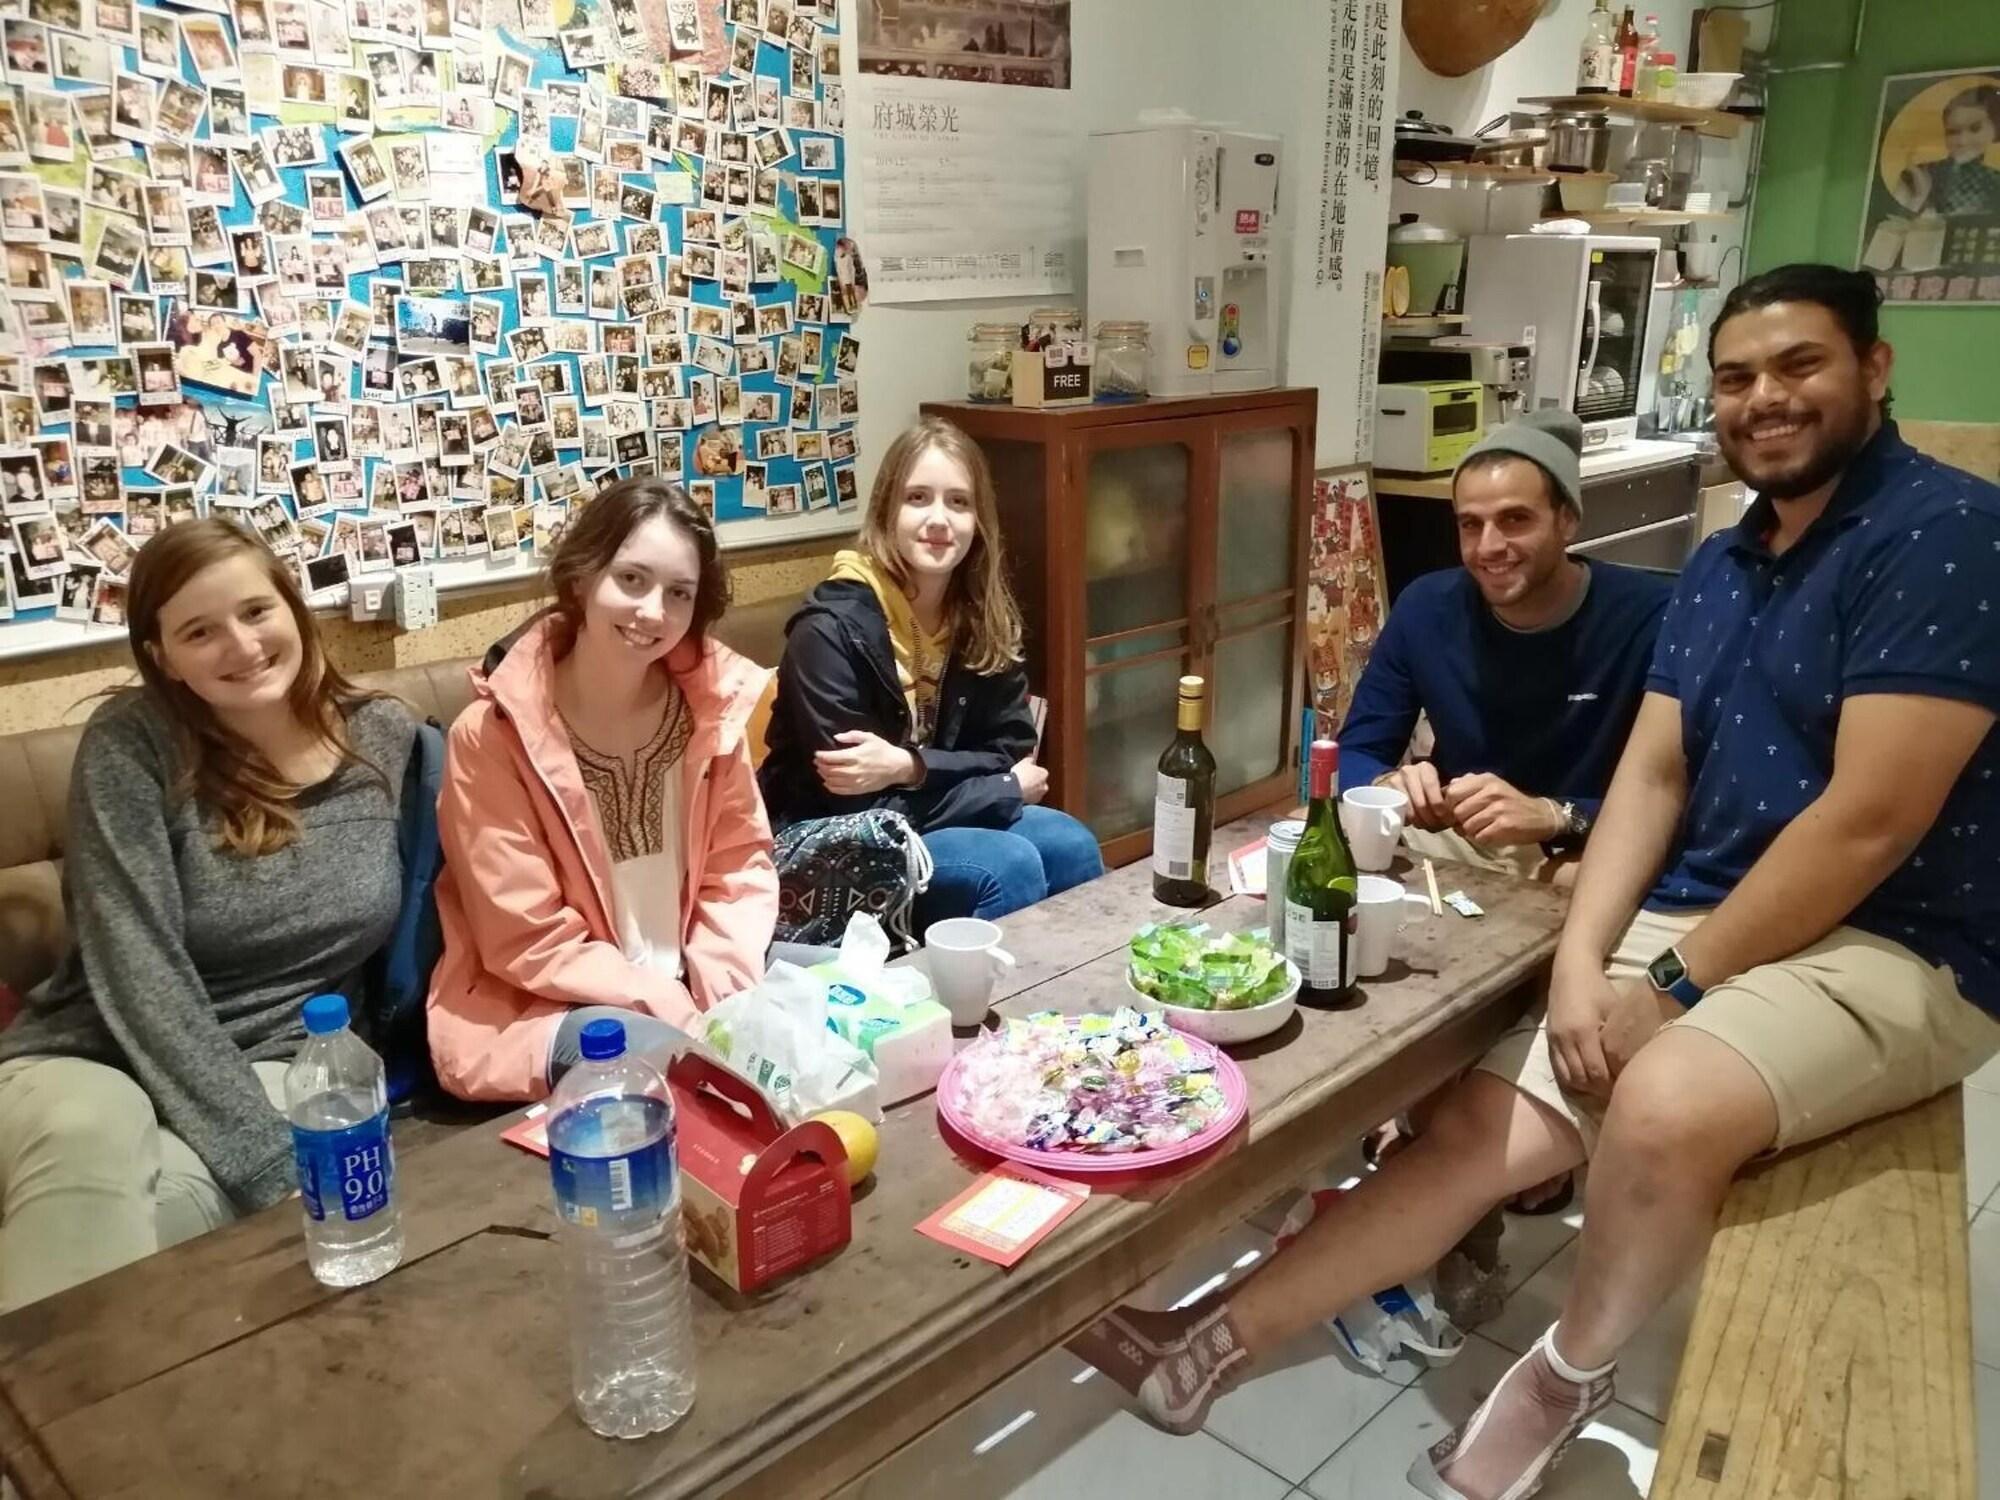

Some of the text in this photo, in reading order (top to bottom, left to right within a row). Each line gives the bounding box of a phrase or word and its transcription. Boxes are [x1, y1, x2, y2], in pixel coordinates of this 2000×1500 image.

[873, 101, 959, 132] 府城榮光
[1319, 199, 1328, 230] from
[1054, 374, 1081, 387] FREE
[344, 1146, 380, 1177] PH
[345, 1170, 383, 1203] 9.0
